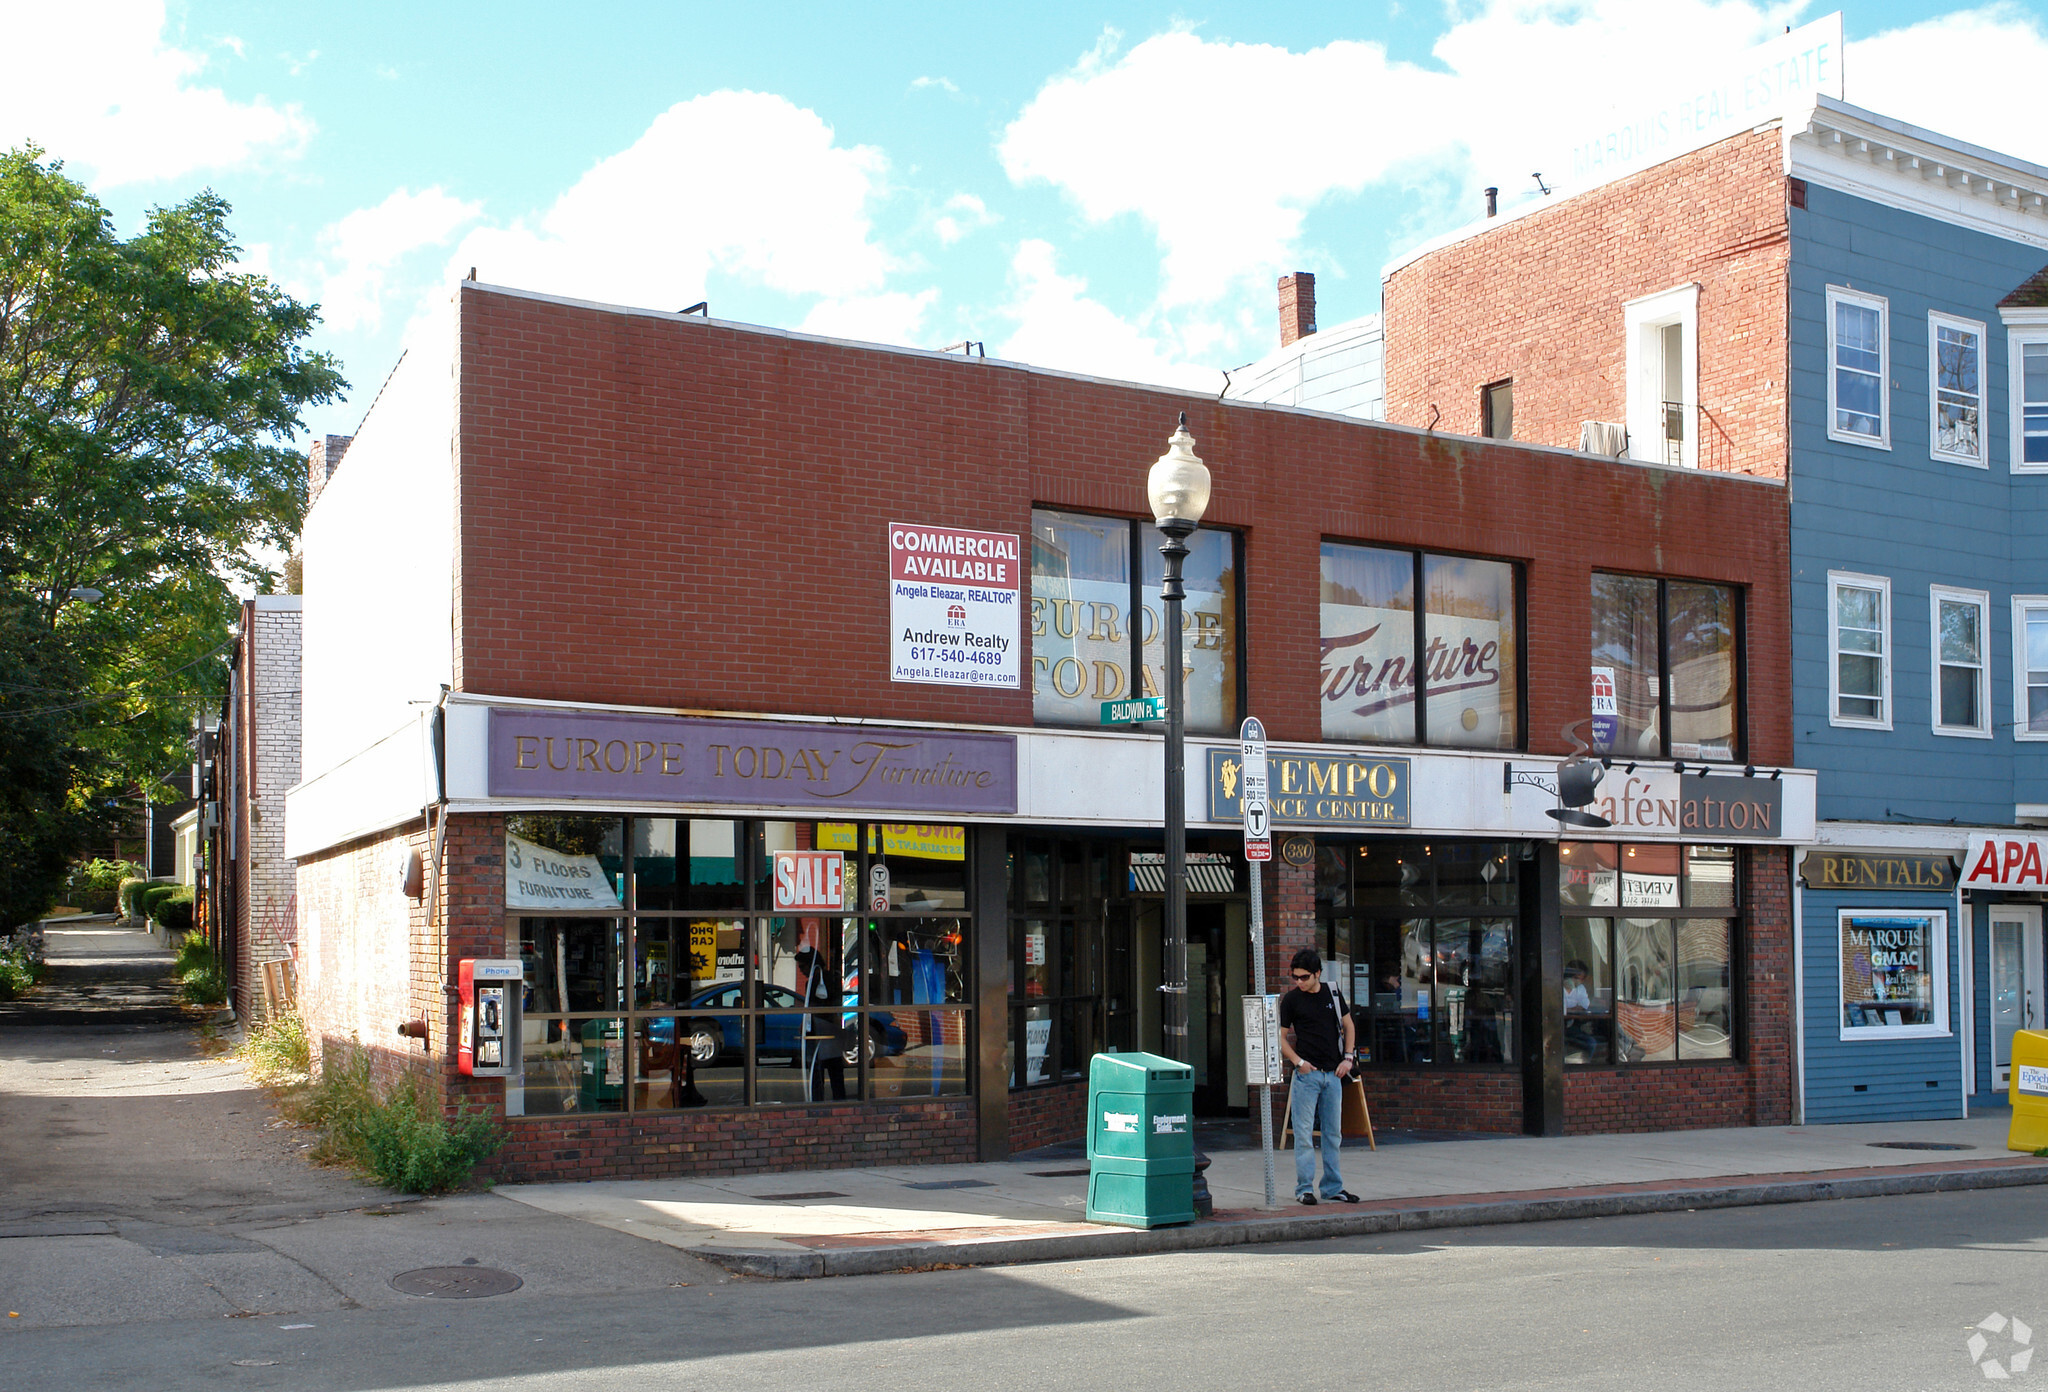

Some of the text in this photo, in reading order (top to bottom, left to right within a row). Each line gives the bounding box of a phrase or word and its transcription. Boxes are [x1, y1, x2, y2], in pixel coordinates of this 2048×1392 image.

[1679, 85, 1735, 137] REAL
[1743, 42, 1831, 112] ESTATE
[892, 530, 1017, 560] COMMERCIAL
[903, 556, 1007, 582] AVAILABLE
[895, 584, 929, 600] Angela
[930, 587, 967, 603] Eleazar,
[947, 618, 966, 628] ERA
[1031, 596, 1221, 650] EUROE
[903, 627, 1010, 653] Andrew Realty
[911, 646, 1003, 666] 617-540-4689
[896, 664, 1017, 683] Angela.Eleazar@era.com
[1321, 622, 1499, 718] urnture
[1111, 702, 1145, 721] BALDWIN
[1146, 704, 1154, 718] PL
[1244, 745, 1253, 755] 57
[514, 735, 998, 799] EUROPE TODAY Furniture
[1266, 760, 1397, 799] EMPO
[1239, 798, 1395, 820] NCE CENTER
[1250, 810, 1264, 830] T
[508, 840, 523, 869] 3
[1288, 841, 1312, 858] 380
[533, 857, 592, 879] FLOORS
[1822, 857, 1944, 886] RENTALS
[1967, 840, 2048, 885] APA
[518, 880, 595, 900] FURNITURE
[777, 856, 841, 906] SALE
[1850, 930, 1920, 949] MARQUIS
[1871, 951, 1918, 966] GMAC
